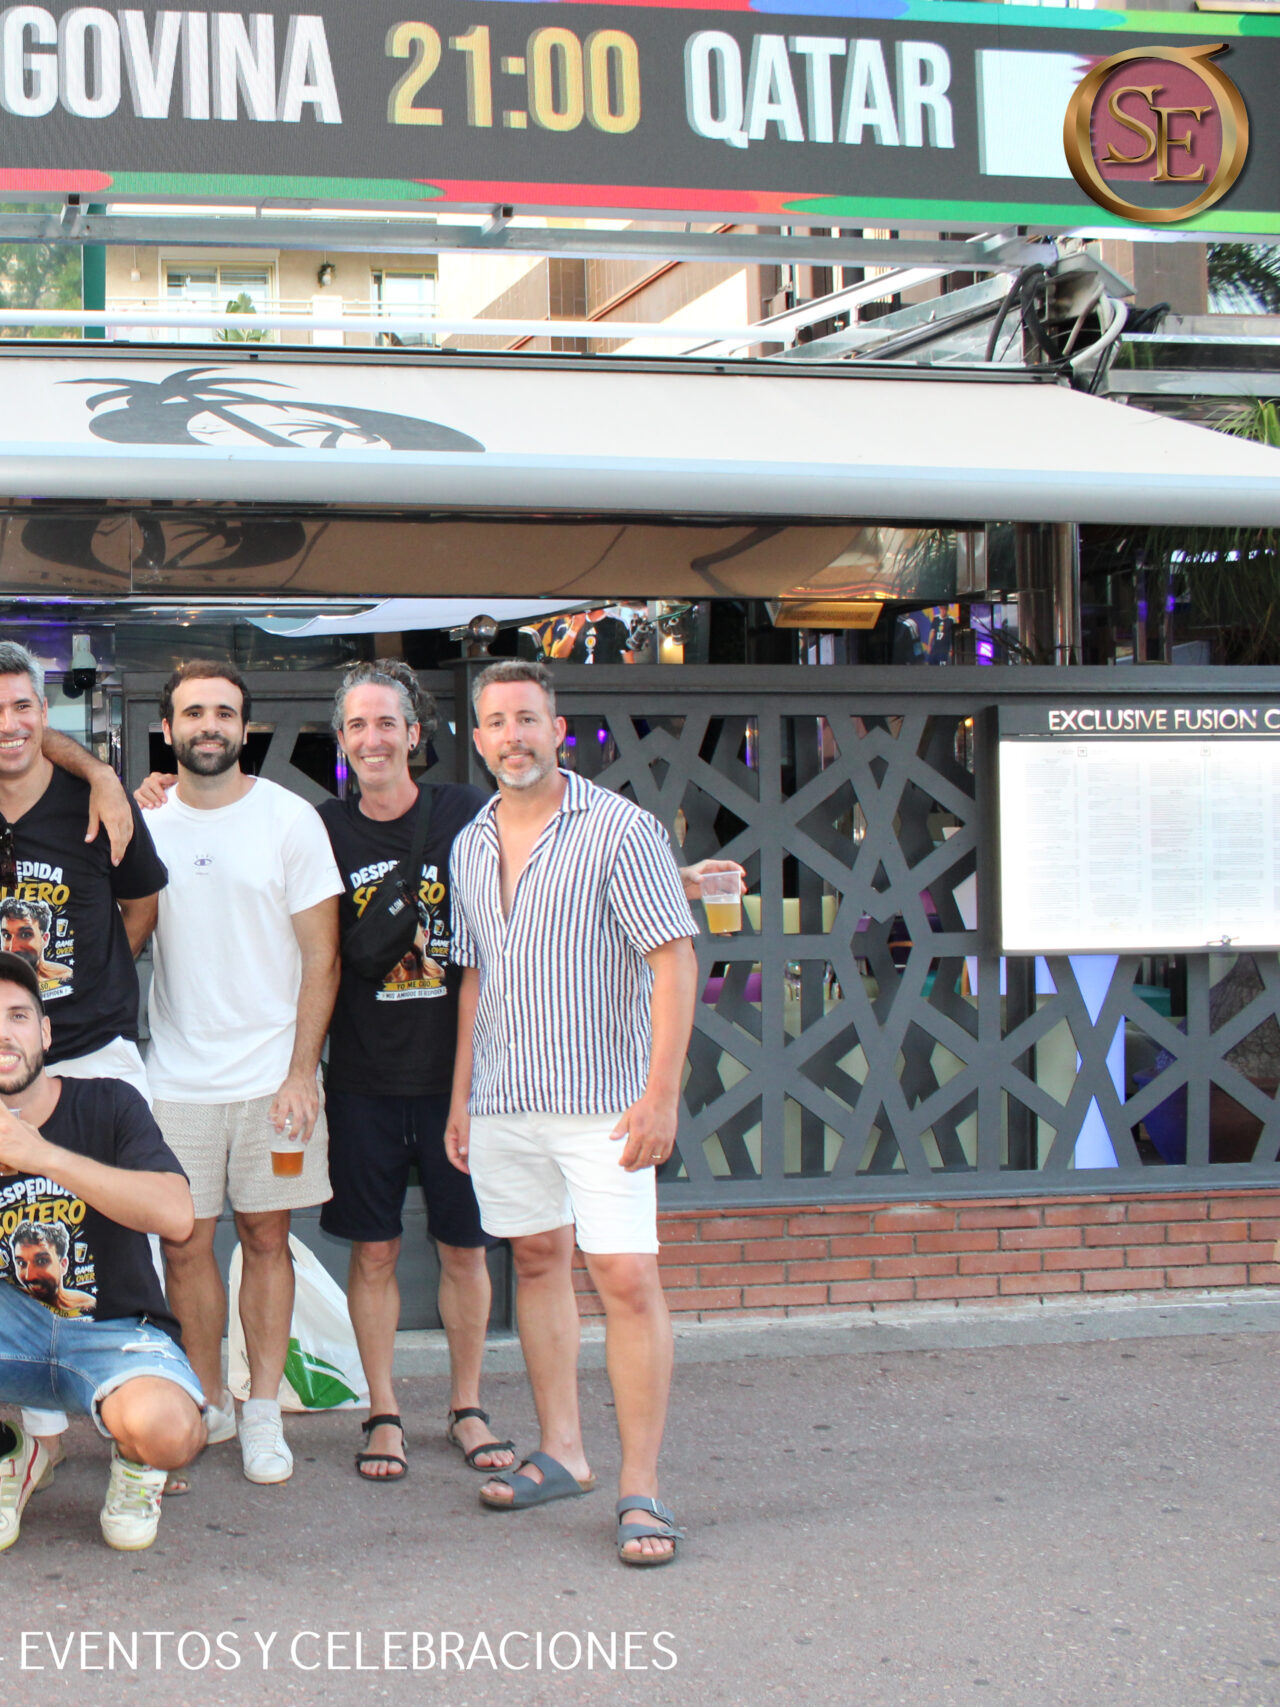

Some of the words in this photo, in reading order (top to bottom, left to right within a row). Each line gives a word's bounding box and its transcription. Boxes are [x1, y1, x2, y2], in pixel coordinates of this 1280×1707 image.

[385, 21, 641, 134] 21:00
[685, 31, 955, 149] QATAR
[1048, 709, 1168, 731] EXCLUSIVE
[1174, 709, 1257, 730] FUSION
[27, 1196, 36, 1204] DE
[74, 1264, 95, 1276] GAME
